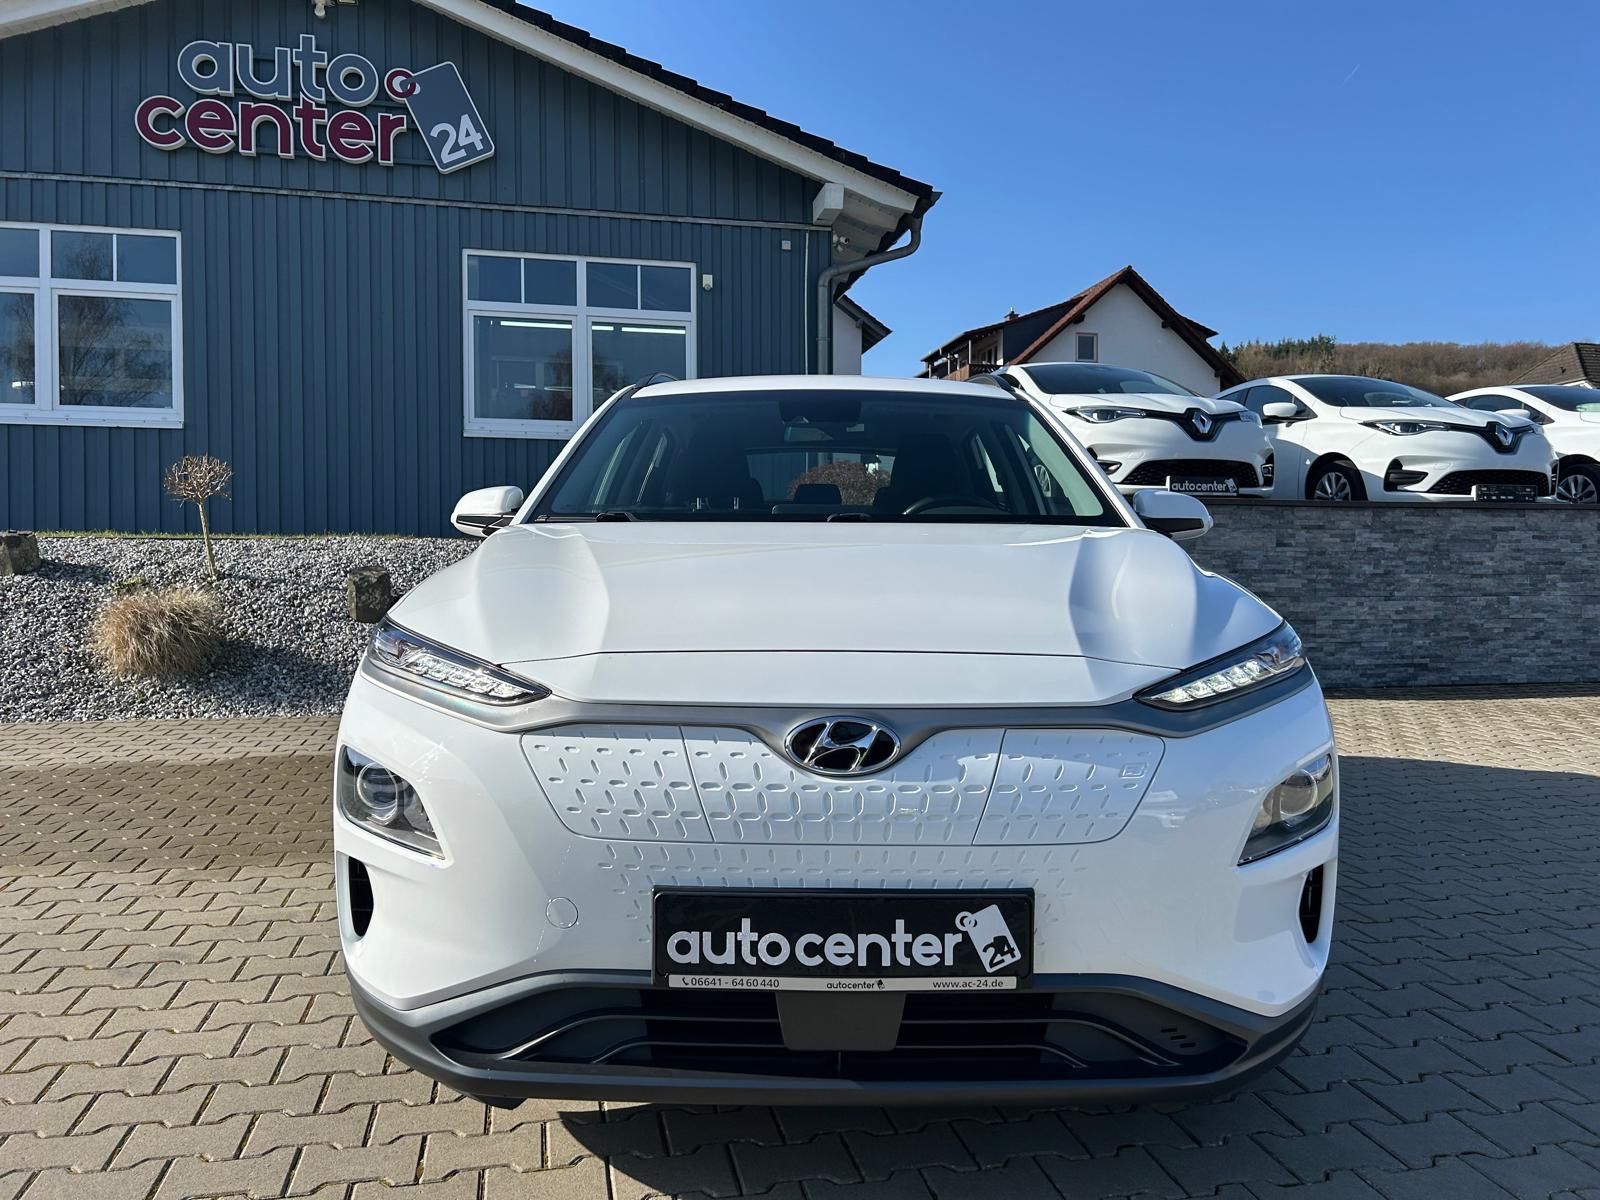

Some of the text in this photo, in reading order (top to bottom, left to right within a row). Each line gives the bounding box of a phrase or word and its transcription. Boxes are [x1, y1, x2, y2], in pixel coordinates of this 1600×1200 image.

[177, 33, 379, 107] auto
[134, 95, 407, 167] center
[430, 113, 483, 164] 24
[1171, 480, 1227, 491] autocenter
[666, 917, 963, 968] autocenter
[981, 935, 1016, 969] 24
[690, 977, 722, 987] 06641
[826, 980, 875, 989] autocenter
[932, 979, 1004, 988] www.ac-24.de
